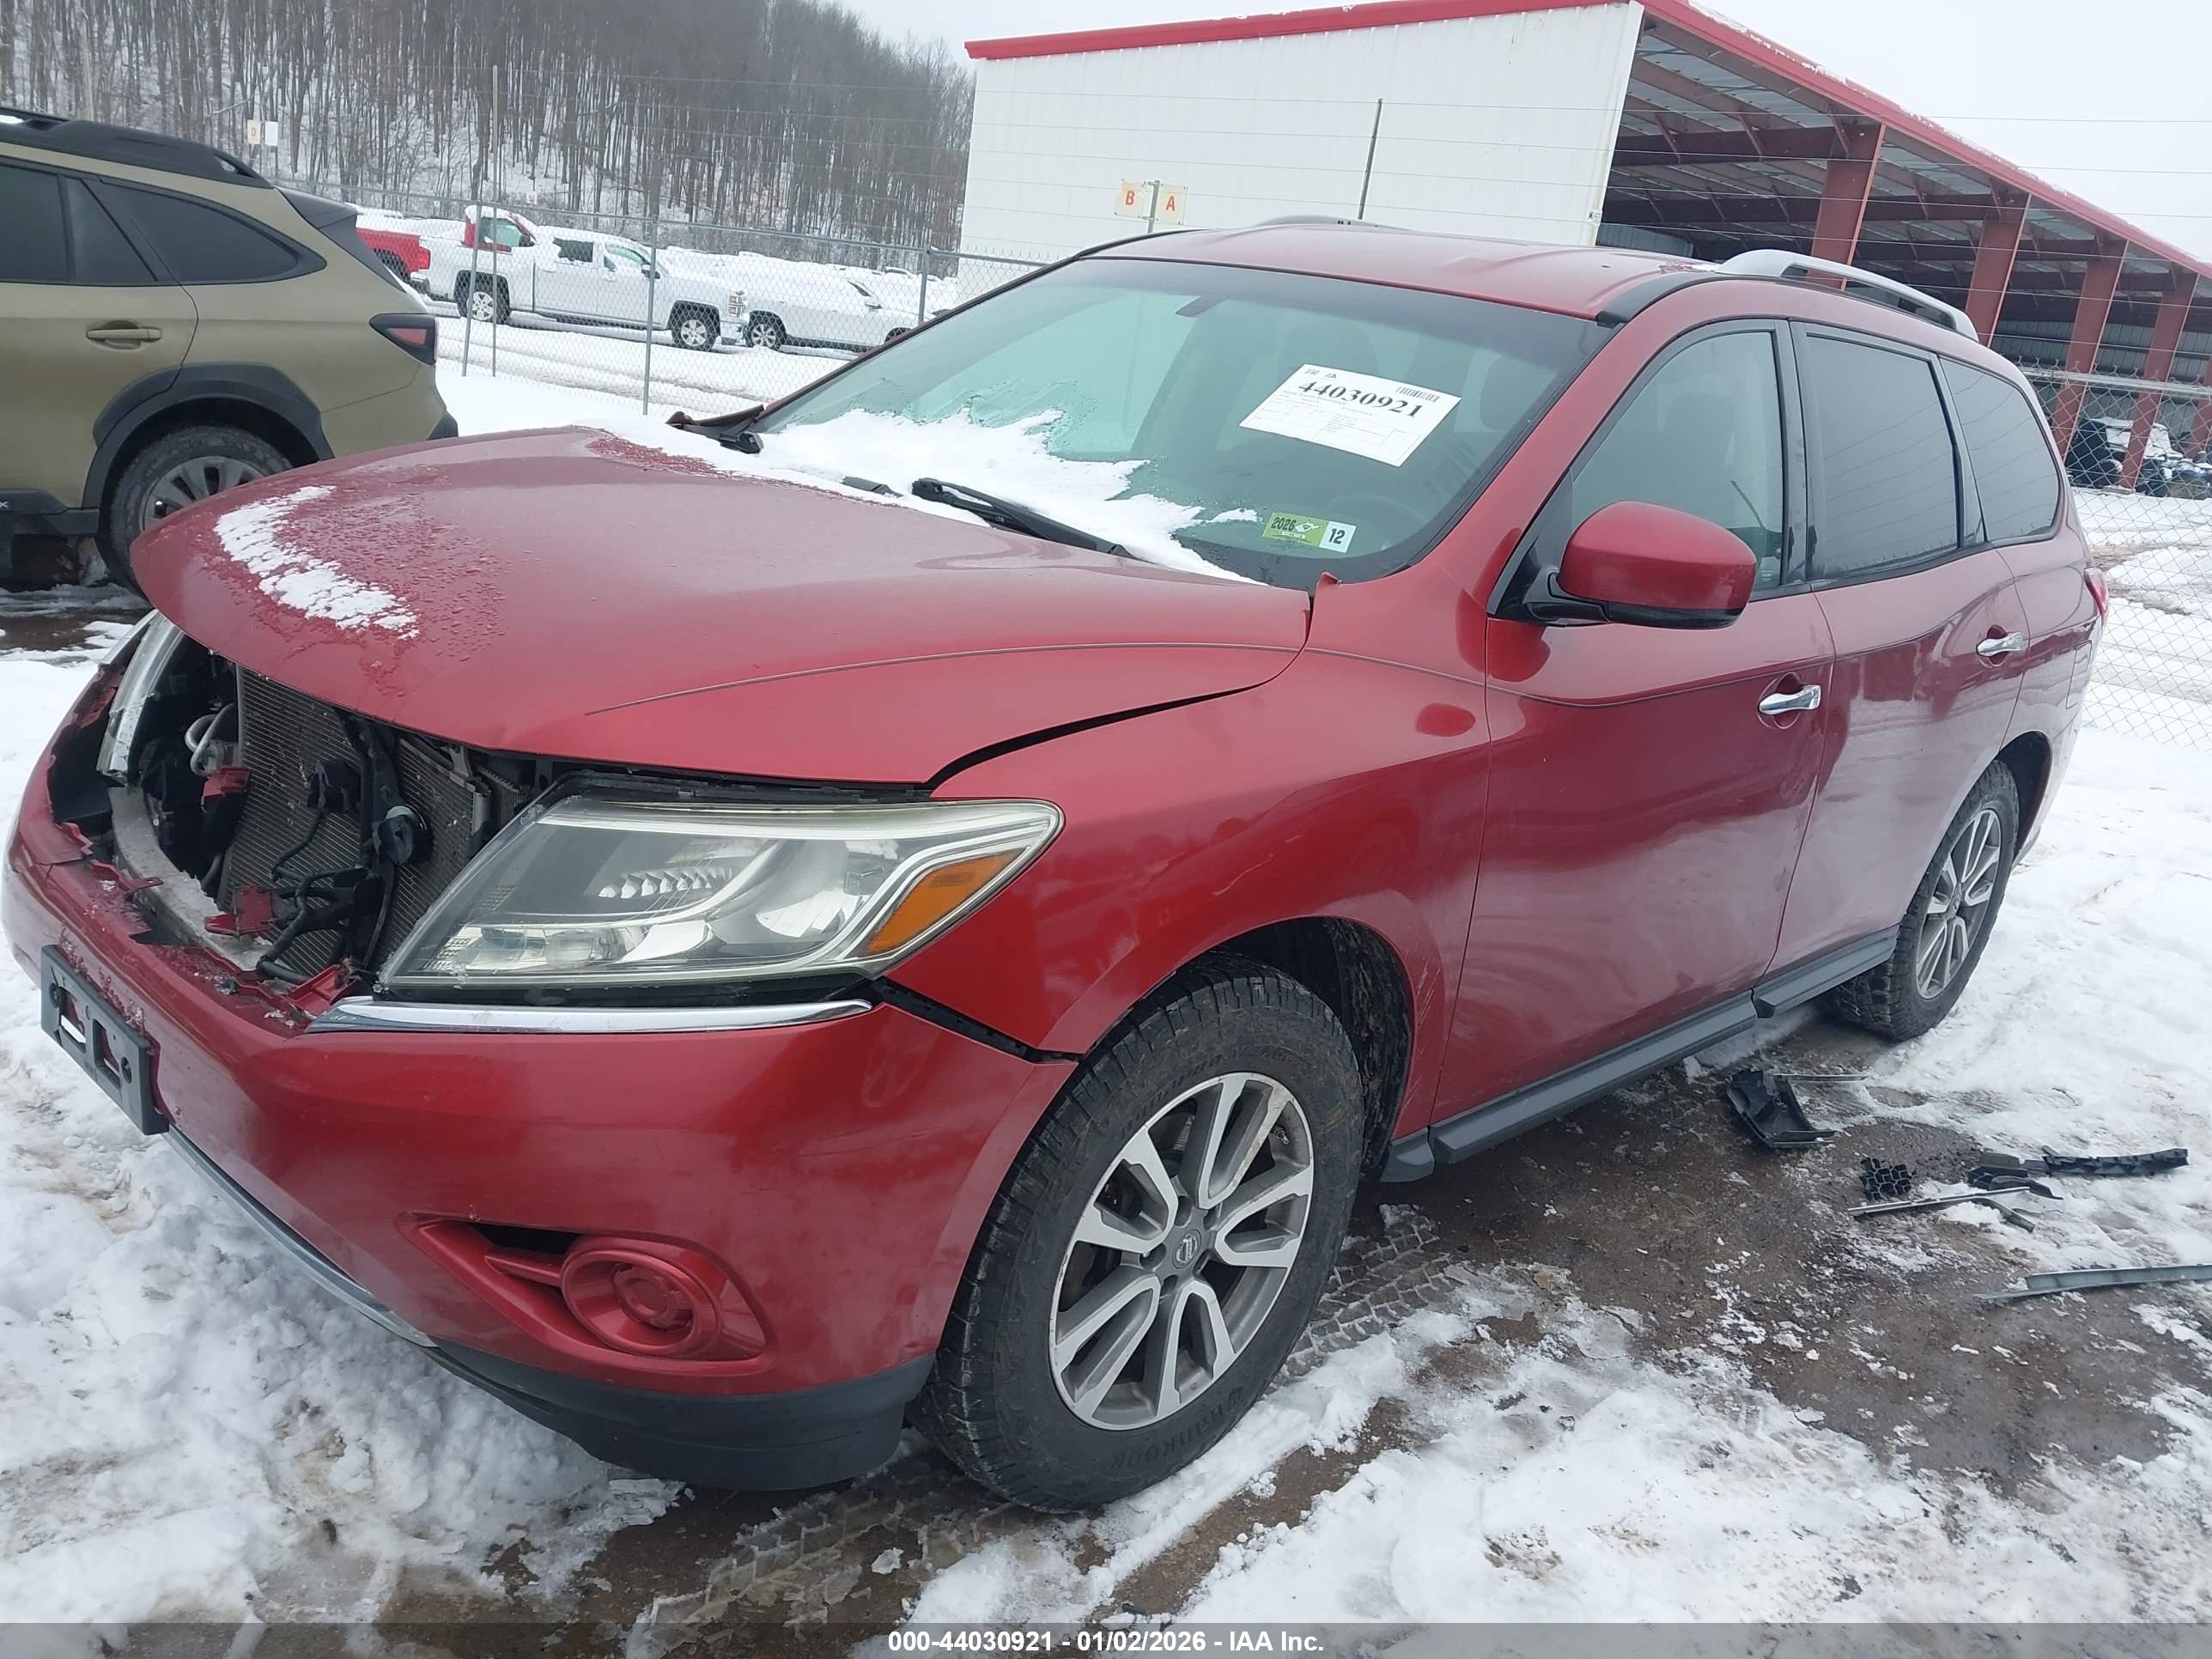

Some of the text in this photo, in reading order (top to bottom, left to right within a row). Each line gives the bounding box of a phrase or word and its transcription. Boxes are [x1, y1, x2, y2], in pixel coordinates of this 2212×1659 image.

[1125, 190, 1135, 205] B
[1165, 196, 1176, 211] A
[1297, 380, 1424, 418] 44030921
[1270, 516, 1297, 532] 2026
[1328, 528, 1346, 544] 12
